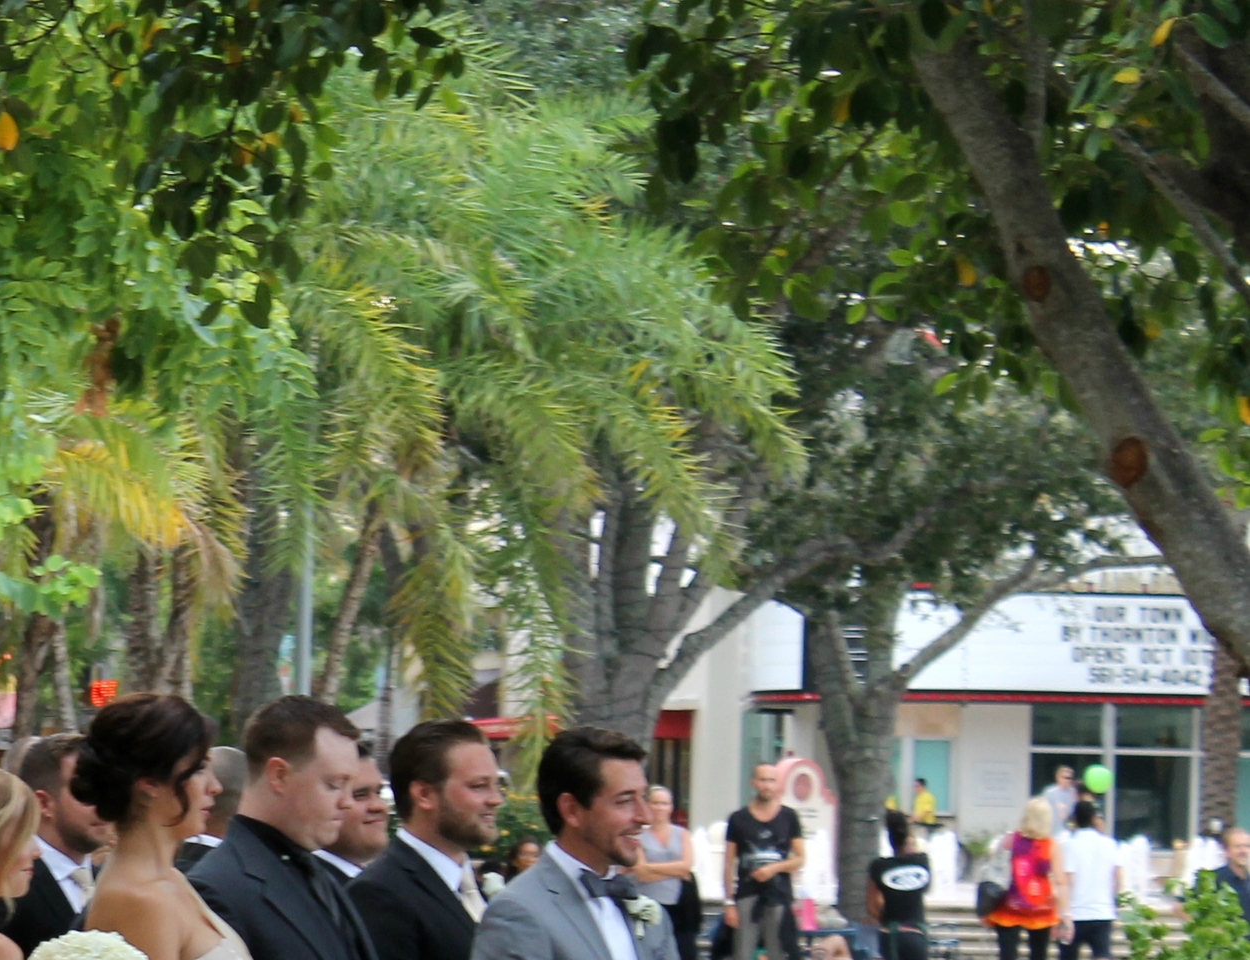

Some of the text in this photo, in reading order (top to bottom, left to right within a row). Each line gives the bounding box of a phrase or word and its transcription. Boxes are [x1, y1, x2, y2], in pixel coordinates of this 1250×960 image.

[1095, 606, 1183, 623] OUR TOWN
[1090, 627, 1178, 643] THORNTON
[1072, 646, 1125, 662] OPENS
